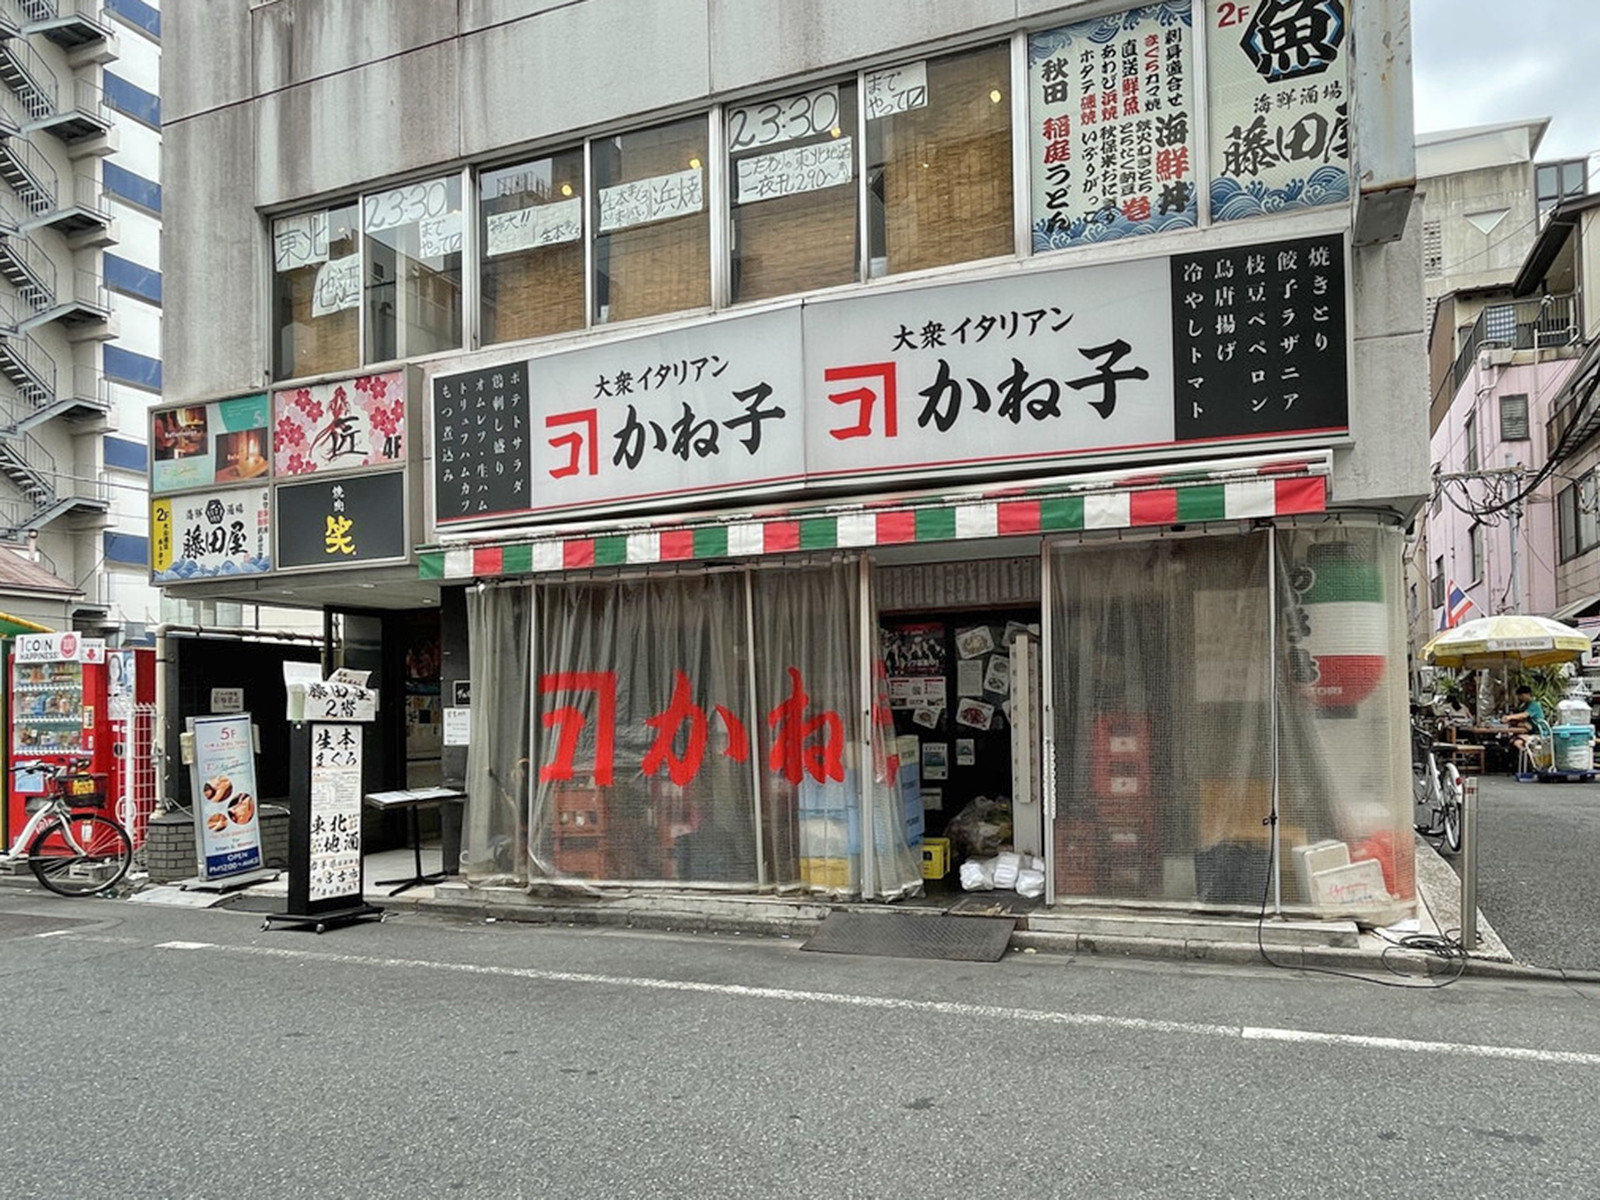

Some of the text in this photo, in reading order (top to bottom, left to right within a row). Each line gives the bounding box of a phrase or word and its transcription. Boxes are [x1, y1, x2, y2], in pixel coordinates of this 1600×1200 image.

[1217, 2, 1250, 28] 2F
[866, 70, 903, 94] まで
[1080, 49, 1097, 126] ホタテ磯焼
[1101, 43, 1119, 122] あわび浜焼
[1121, 38, 1140, 117] 直送鮮魚
[1165, 27, 1184, 107] 刺身盛合せ
[728, 91, 839, 149] 23:30
[1254, 80, 1343, 114] 海鮮酒場
[1041, 56, 1072, 234] 秋田 稲庭うどん
[1155, 111, 1191, 216] 海鮮丼
[365, 181, 447, 229] 23:30
[421, 218, 447, 238] まで
[275, 214, 328, 267] 東北
[1214, 258, 1237, 362] 鳥唐揚げ
[1308, 246, 1331, 352] 焼きとり
[891, 307, 1074, 352] 大衆イタリアン
[1183, 262, 1204, 419] 冷やしトマト
[1245, 254, 1269, 412] 枝豆ペペロン
[1277, 250, 1300, 411] 餃子ラザニア
[594, 355, 730, 400] 大衆イタリアン
[917, 338, 1150, 433] かね子
[383, 435, 402, 460] 4F
[441, 384, 454, 483] もつ煮込み
[459, 382, 471, 512] トリュフハムカツ
[475, 378, 489, 511] オムレツ・生ハム
[510, 370, 524, 494] ポテトサラダ
[612, 381, 786, 470] かね子
[182, 520, 249, 560] 藤田屋
[325, 515, 355, 555] 笑
[308, 681, 371, 702] 藤田屋
[325, 699, 357, 718] 2階
[220, 727, 237, 741] 5F
[315, 727, 357, 751] 生本
[315, 751, 358, 769] まぐろ
[311, 813, 348, 836] 東北
[324, 832, 360, 853] 地酒
[227, 852, 248, 861] OPEN
